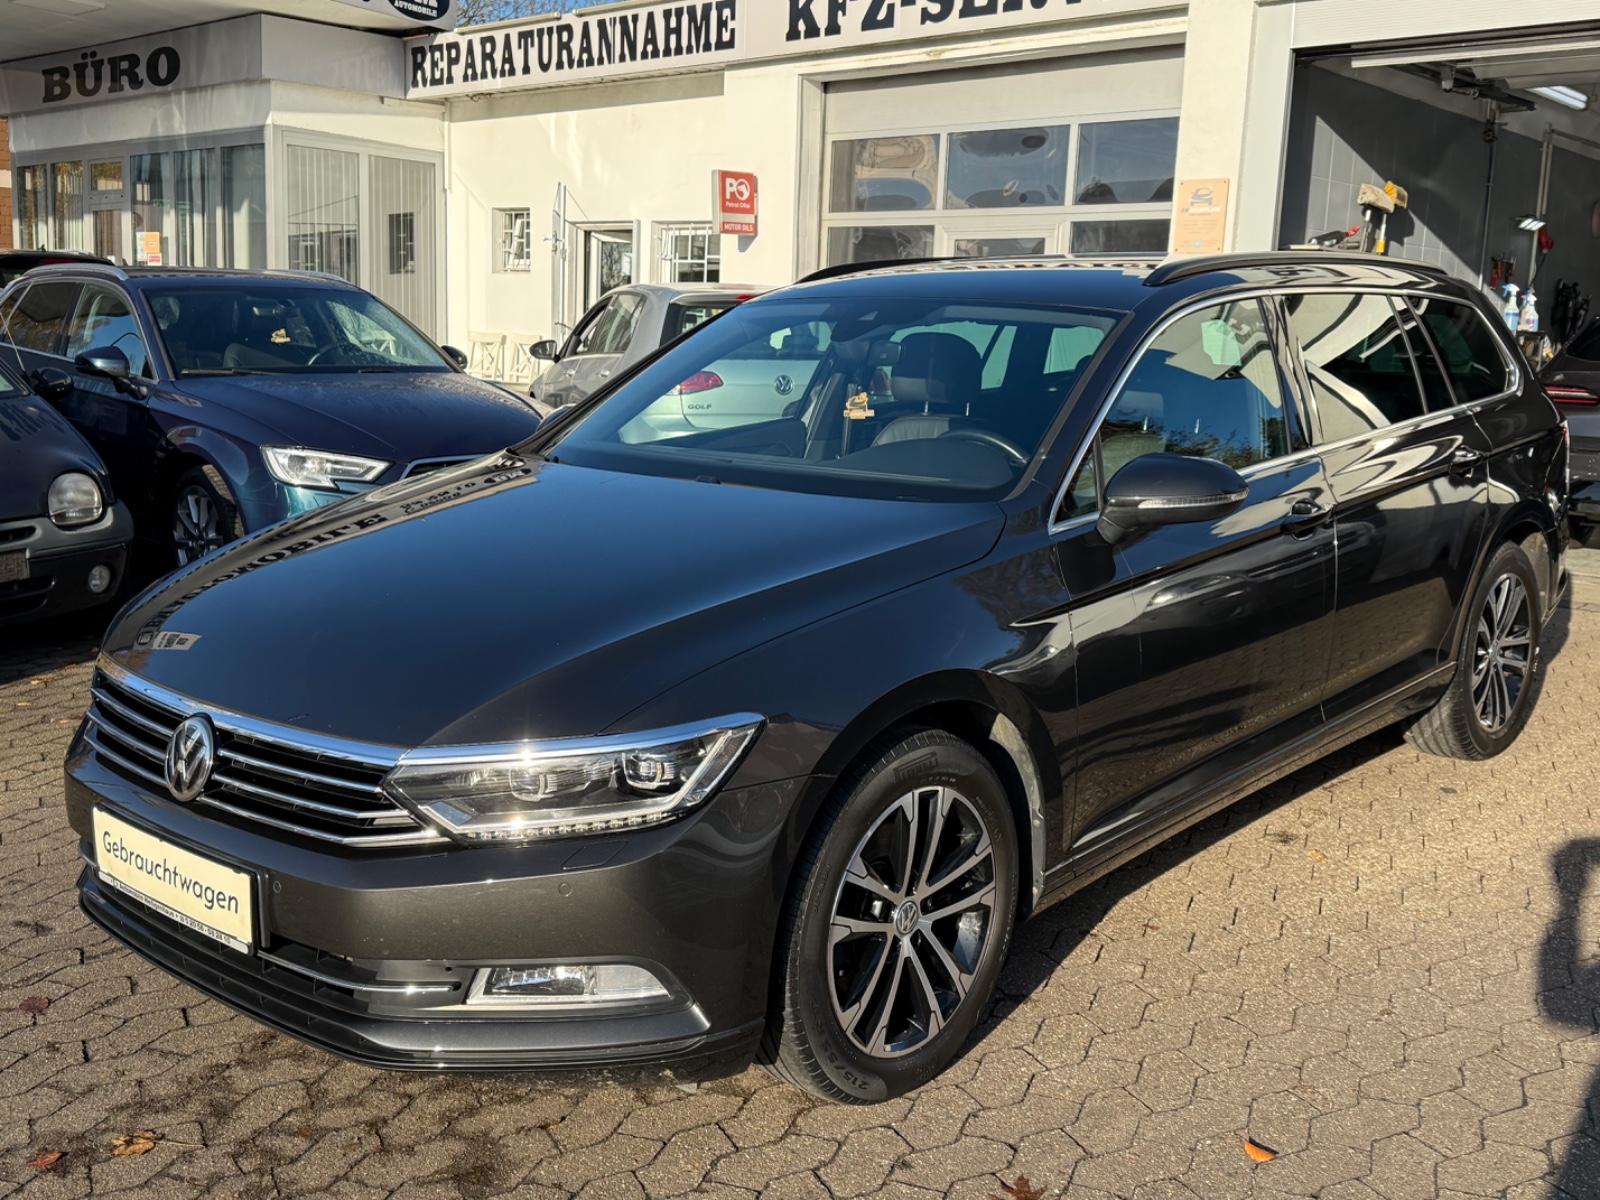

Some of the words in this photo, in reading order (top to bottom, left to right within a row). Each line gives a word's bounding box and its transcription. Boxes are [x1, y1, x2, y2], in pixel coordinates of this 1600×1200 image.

[394, 1, 438, 17] AUTOMOBILE
[786, 0, 1082, 41] KFZ-
[411, 0, 736, 88] REPARATURANNAHME
[41, 46, 181, 103] BÜRO
[724, 223, 741, 231] MOTOR
[103, 831, 238, 914] Gebrauchtwagen
